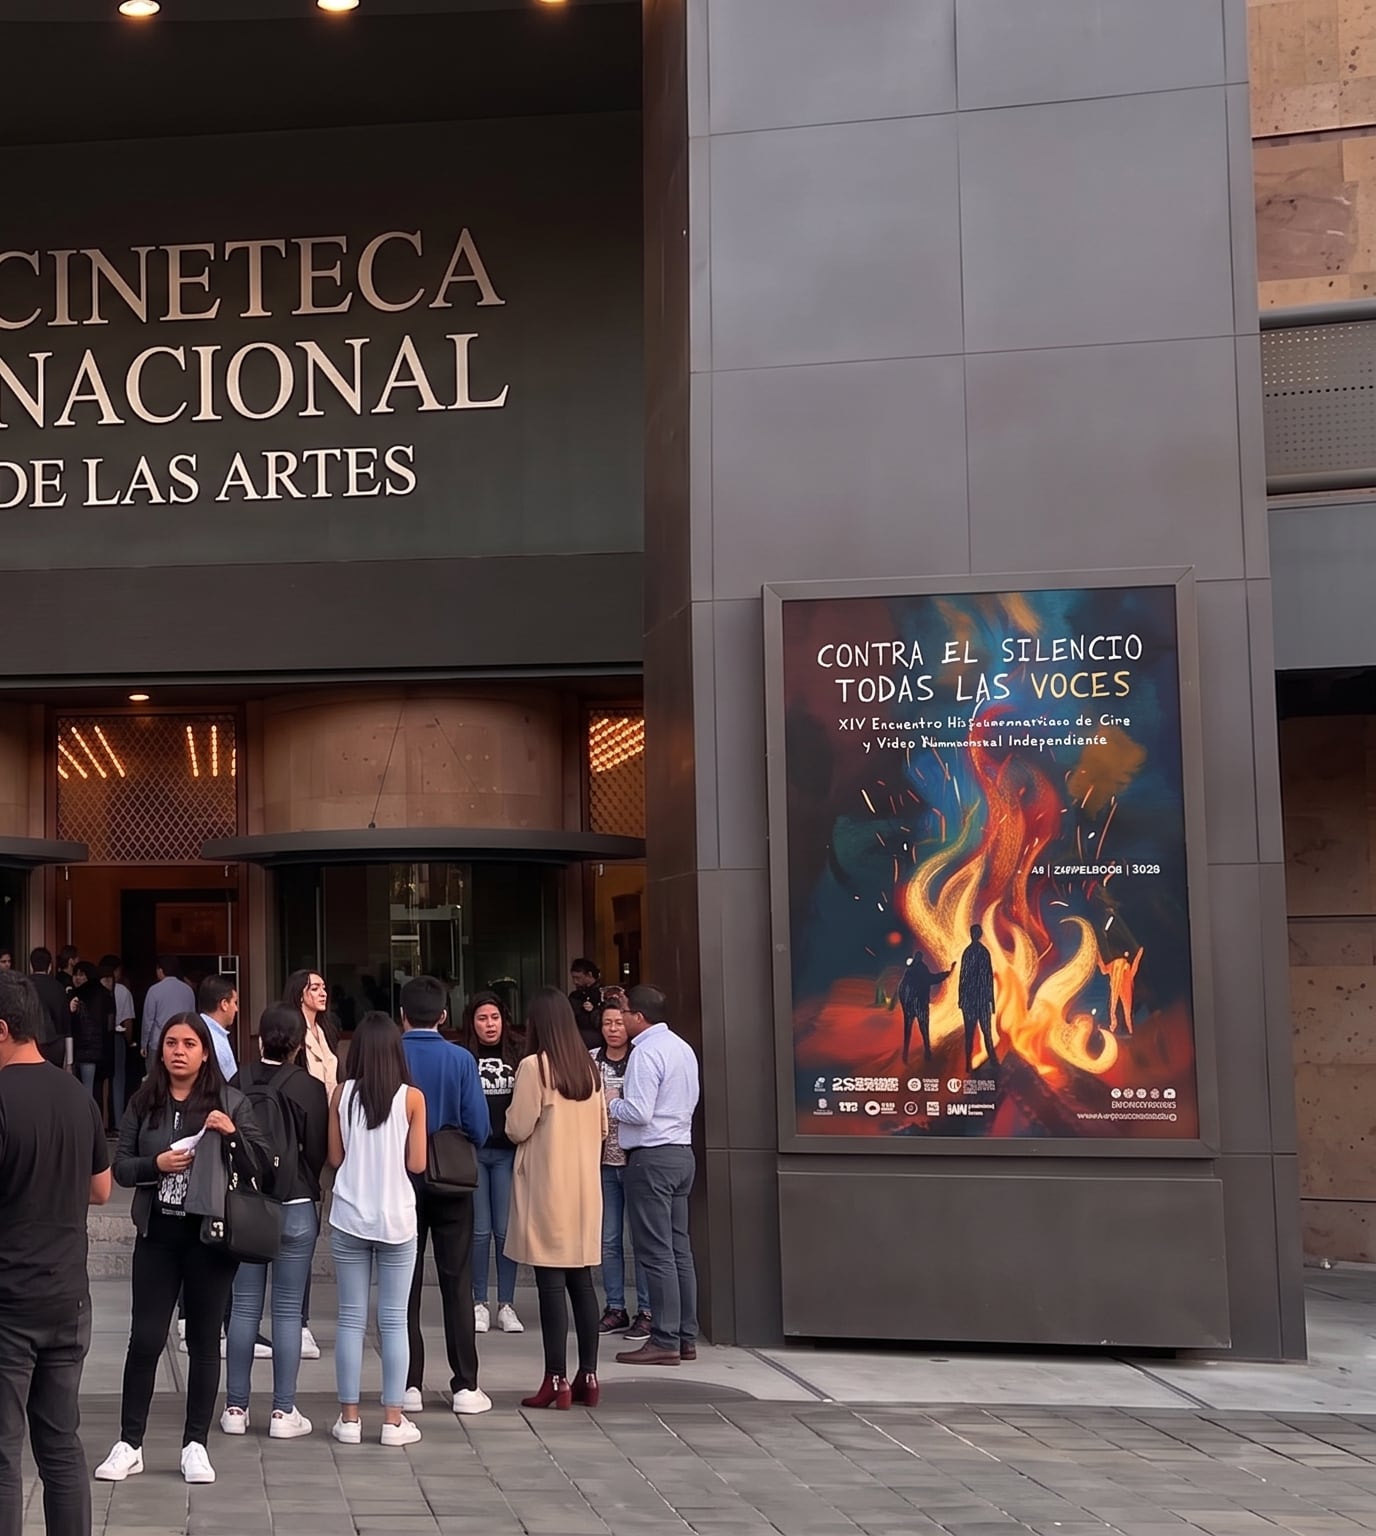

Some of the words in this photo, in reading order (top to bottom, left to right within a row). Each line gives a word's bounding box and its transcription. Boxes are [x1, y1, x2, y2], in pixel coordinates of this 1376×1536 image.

[83, 454, 200, 506] LAS
[215, 444, 418, 503] ARTES
[817, 640, 924, 670] CONTRA
[941, 641, 978, 665] EL
[1001, 634, 1143, 663] SILENCIO
[835, 674, 934, 703] TODAS
[956, 673, 1010, 702] LAS
[1031, 671, 1130, 699] VOCES
[838, 718, 866, 731] XIV
[872, 717, 942, 731] Encuentro
[1075, 714, 1092, 726] de
[863, 739, 871, 753] y
[877, 737, 916, 749] Video
